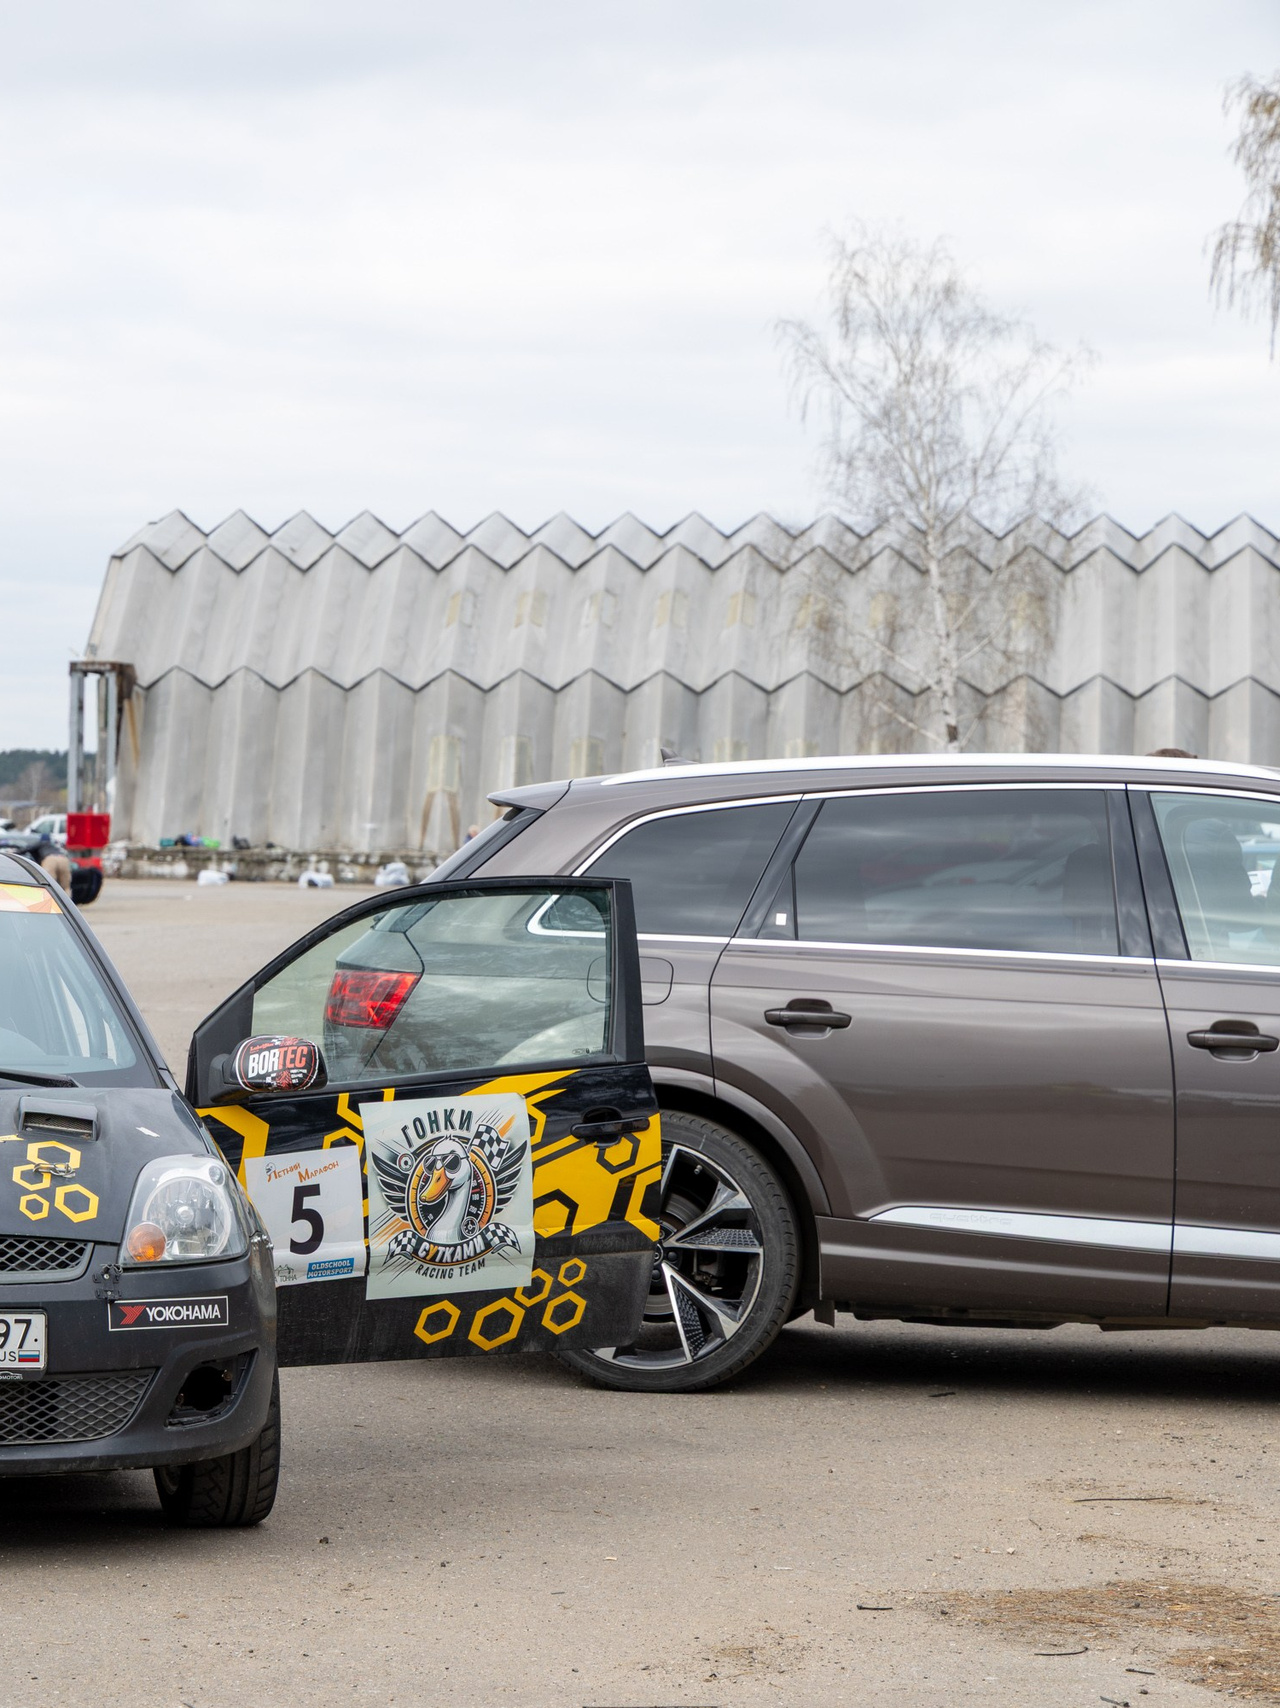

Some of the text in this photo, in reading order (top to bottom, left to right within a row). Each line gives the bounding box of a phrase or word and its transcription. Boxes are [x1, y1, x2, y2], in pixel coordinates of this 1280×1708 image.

[248, 1046, 308, 1078] BORTEC
[401, 1108, 474, 1149] ГОНКИ
[289, 1183, 324, 1255] 5
[418, 1234, 485, 1263] СУТКАМИ
[307, 1267, 353, 1278] MOTORSPORT
[311, 1259, 351, 1270] OLDSCHOOL
[415, 1258, 486, 1280] RACING TEAM
[145, 1304, 221, 1321] YOKOHAMA
